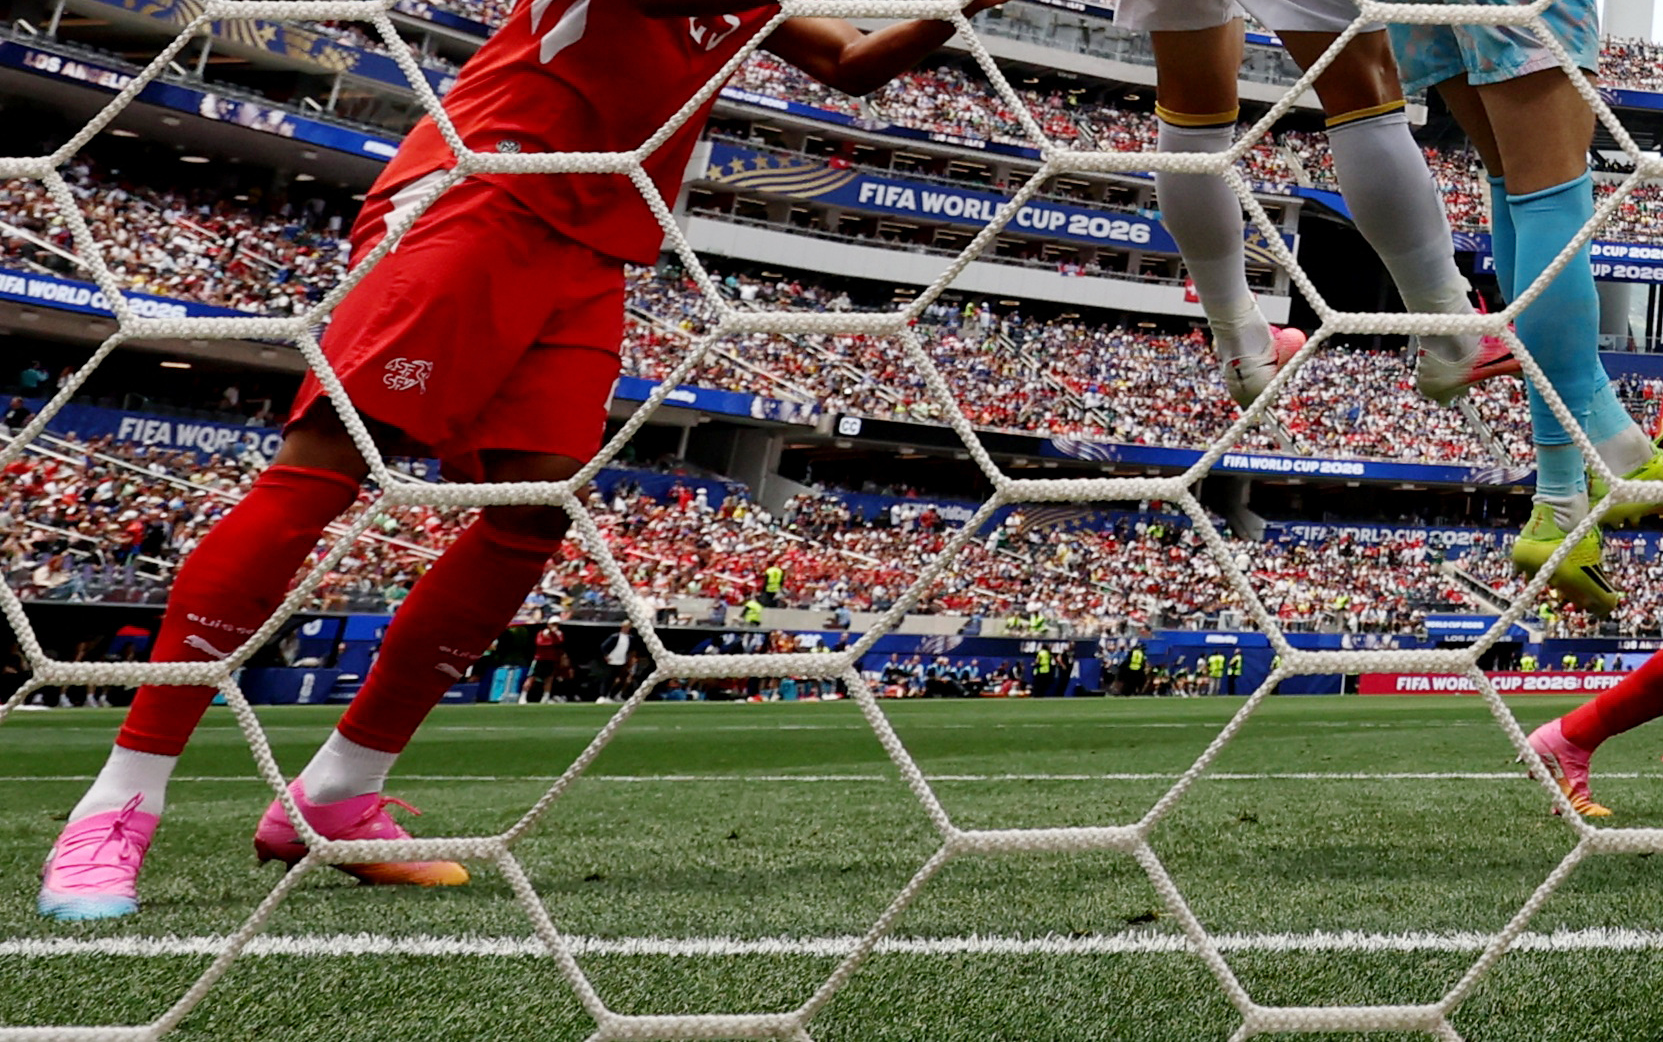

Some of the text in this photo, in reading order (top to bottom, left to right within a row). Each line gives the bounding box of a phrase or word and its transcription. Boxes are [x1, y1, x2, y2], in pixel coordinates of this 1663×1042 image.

[22, 51, 62, 74] LOS
[858, 181, 916, 210] FIFA
[1016, 207, 1066, 231] CUP
[1067, 214, 1151, 244] 2026
[1602, 246, 1628, 259] CUP
[27, 279, 91, 308] WORLD
[127, 296, 188, 319] 2026
[117, 417, 173, 446] FIFA
[841, 420, 858, 433] CC
[1222, 454, 1364, 476] FIFA WORLD CUP 2026
[1396, 676, 1430, 691] FIFA
[1489, 675, 1522, 690] CUP
[1523, 675, 1577, 690] 2026
